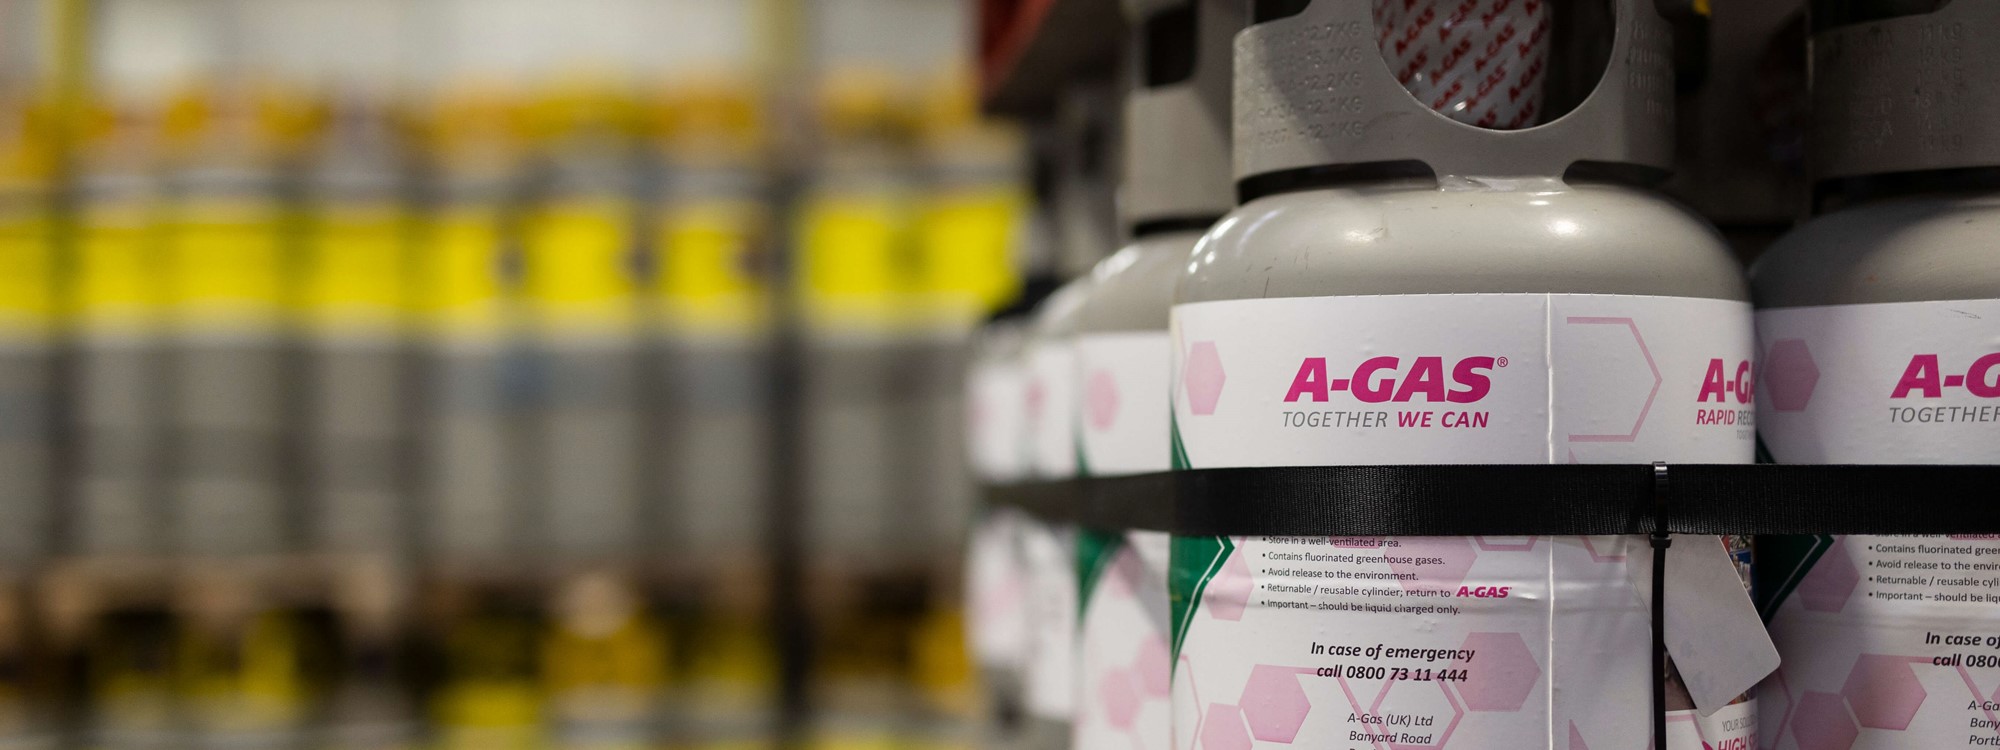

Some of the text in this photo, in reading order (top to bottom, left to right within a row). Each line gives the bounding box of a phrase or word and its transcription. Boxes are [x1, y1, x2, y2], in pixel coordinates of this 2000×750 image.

[1283, 411, 1489, 428] TOGETHER WE CAN
[1696, 409, 1735, 425] RAPID
[1268, 535, 1289, 545] Store
[1291, 536, 1299, 545] in
[1308, 537, 1375, 547] well-ventilated
[1875, 544, 1915, 554] Contains
[1918, 544, 1972, 555] fluorinated
[1268, 551, 1446, 566] Contains fluorinated greenhouse gases.
[1875, 559, 1902, 569] Avoid
[1904, 560, 1938, 570] release
[1941, 562, 1951, 570] to
[1954, 562, 1970, 570] the
[1267, 567, 1290, 577] Avoid
[1292, 568, 1322, 578] release
[1336, 570, 1352, 579] the
[1354, 571, 1419, 581] environment.
[1876, 575, 1927, 585] Returnable
[1936, 577, 1980, 587] reusable
[1267, 583, 1312, 594] Returnable
[1320, 585, 1360, 596] reusable
[1361, 587, 1403, 598] cylinder;
[1406, 590, 1437, 598] return
[1440, 590, 1451, 598] to
[1876, 590, 1923, 601] Important
[1934, 592, 1967, 602] should
[1970, 593, 1983, 603] be
[1986, 594, 2000, 604] liq
[1267, 599, 1309, 610] Important
[1318, 601, 1349, 612] should
[1351, 602, 1363, 612] be
[1365, 603, 1392, 614] liquid
[1394, 603, 1434, 615] charged
[1436, 605, 1461, 616] only.
[1925, 631, 1941, 645] In
[1945, 634, 1982, 646] case
[1310, 641, 1475, 662] In case of emergency
[1932, 653, 2000, 668] call 080
[1316, 664, 1468, 682] call 0800 73 11 444
[1967, 700, 2000, 711] A-Ga
[1347, 712, 1434, 728] A-Gas (UK) Ltd
[1349, 730, 1432, 744] Banyard Road
